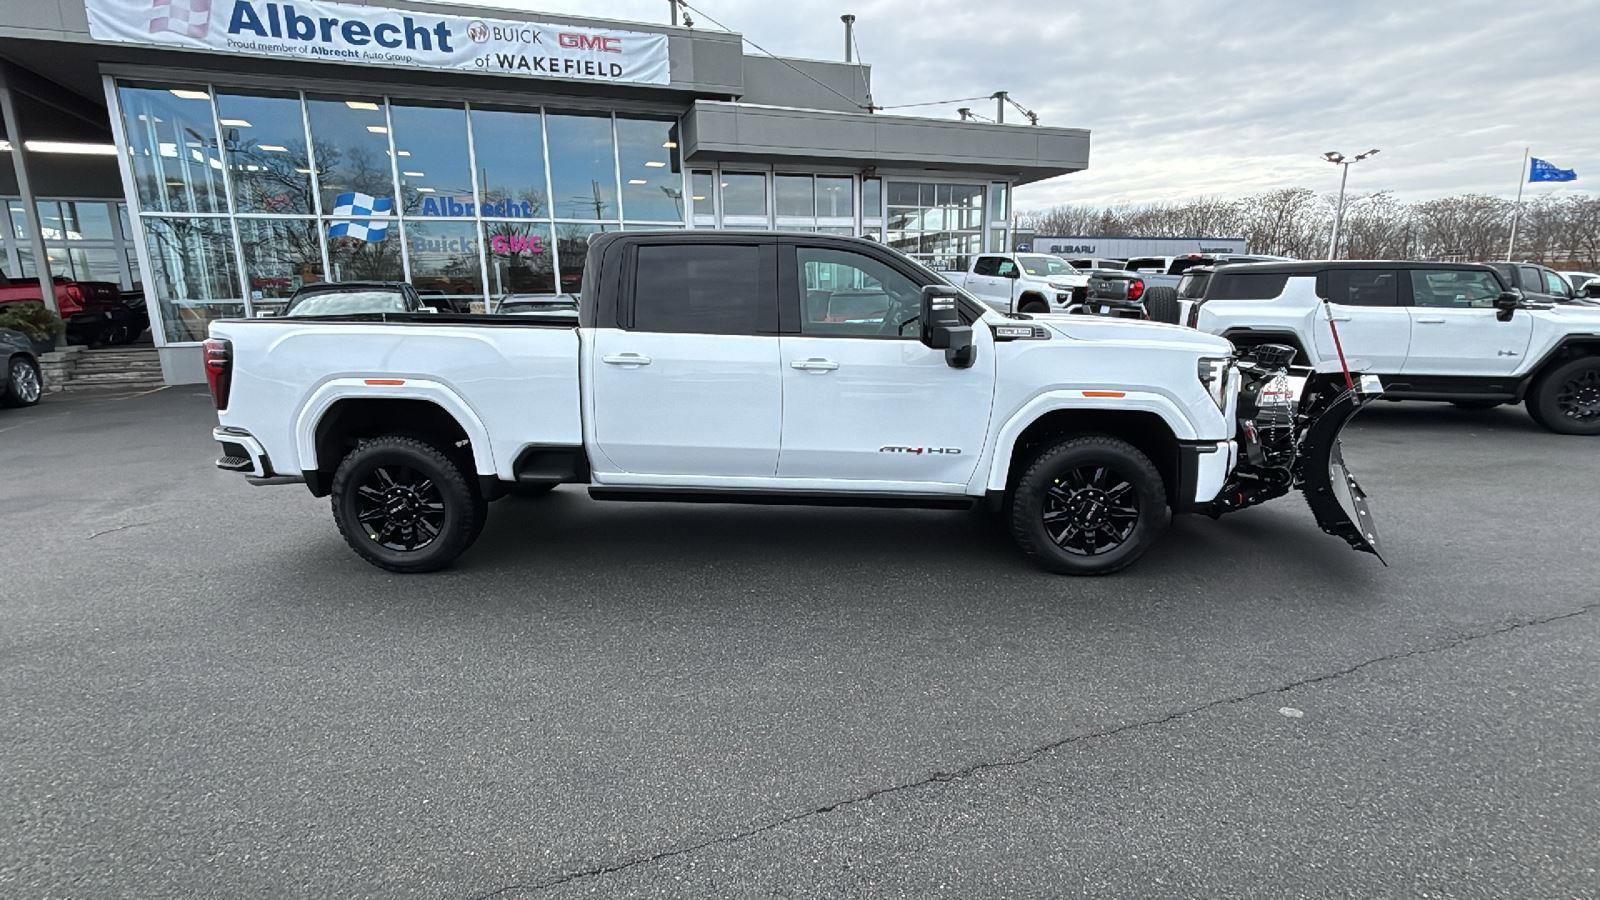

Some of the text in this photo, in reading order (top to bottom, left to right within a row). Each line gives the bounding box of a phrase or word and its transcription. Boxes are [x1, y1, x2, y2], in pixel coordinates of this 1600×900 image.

[227, 0, 454, 53] Albrecht
[226, 38, 412, 62] Proud member of Albrecht Auto Group
[493, 27, 622, 53] BUICK GMC
[475, 53, 623, 77] of WAKEFIELD
[422, 196, 533, 217] Albrecht
[411, 234, 543, 254] Buick GMC
[1050, 244, 1096, 254] SUBARU
[879, 446, 962, 456] AT4 HD
